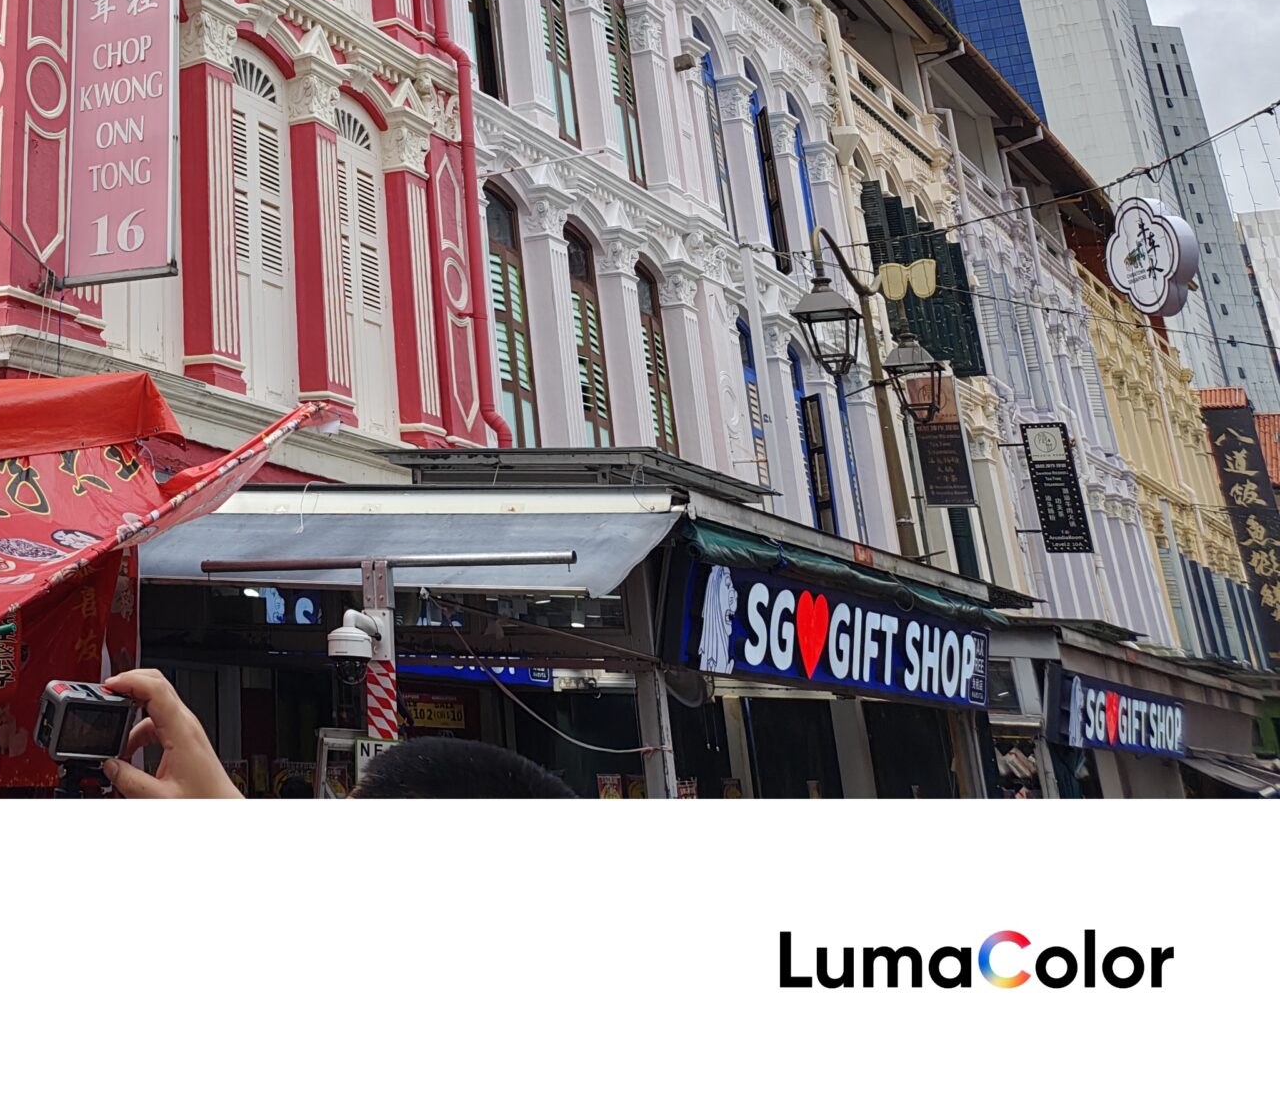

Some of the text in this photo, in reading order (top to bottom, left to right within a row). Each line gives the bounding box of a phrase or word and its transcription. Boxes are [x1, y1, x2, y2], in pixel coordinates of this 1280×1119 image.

[93, 34, 152, 71] CHOP
[80, 69, 164, 113] KWONG
[95, 114, 145, 150] ONN
[88, 155, 151, 193] TONG
[89, 208, 145, 257] 16
[745, 582, 975, 699] SG GIFT SHOP
[1085, 688, 1182, 751] SG GIFT SHOP
